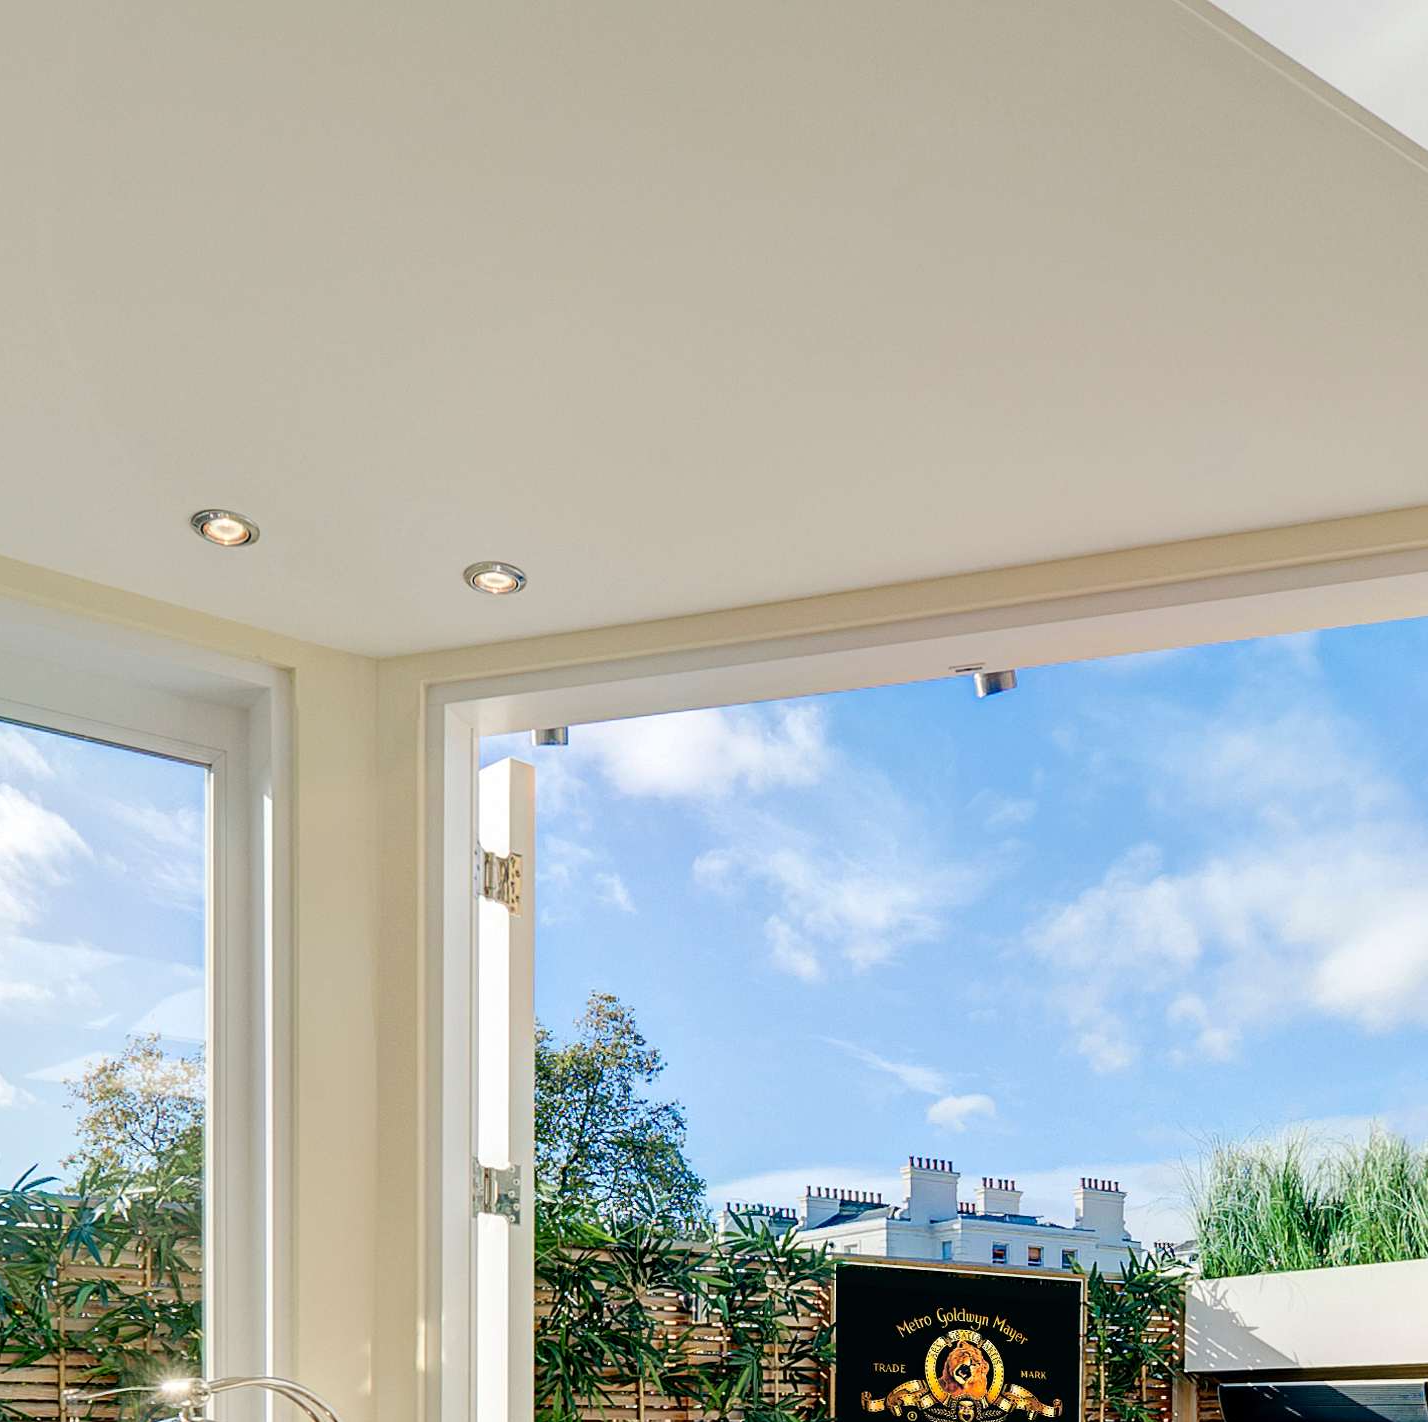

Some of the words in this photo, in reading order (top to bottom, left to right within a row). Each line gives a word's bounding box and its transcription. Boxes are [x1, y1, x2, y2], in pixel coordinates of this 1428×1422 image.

[896, 1315, 932, 1338] Metro
[936, 1307, 989, 1331] Goldwyn
[993, 1315, 1029, 1344] Mayer
[873, 1362, 907, 1374] TRADE
[1020, 1369, 1047, 1380] MARK
